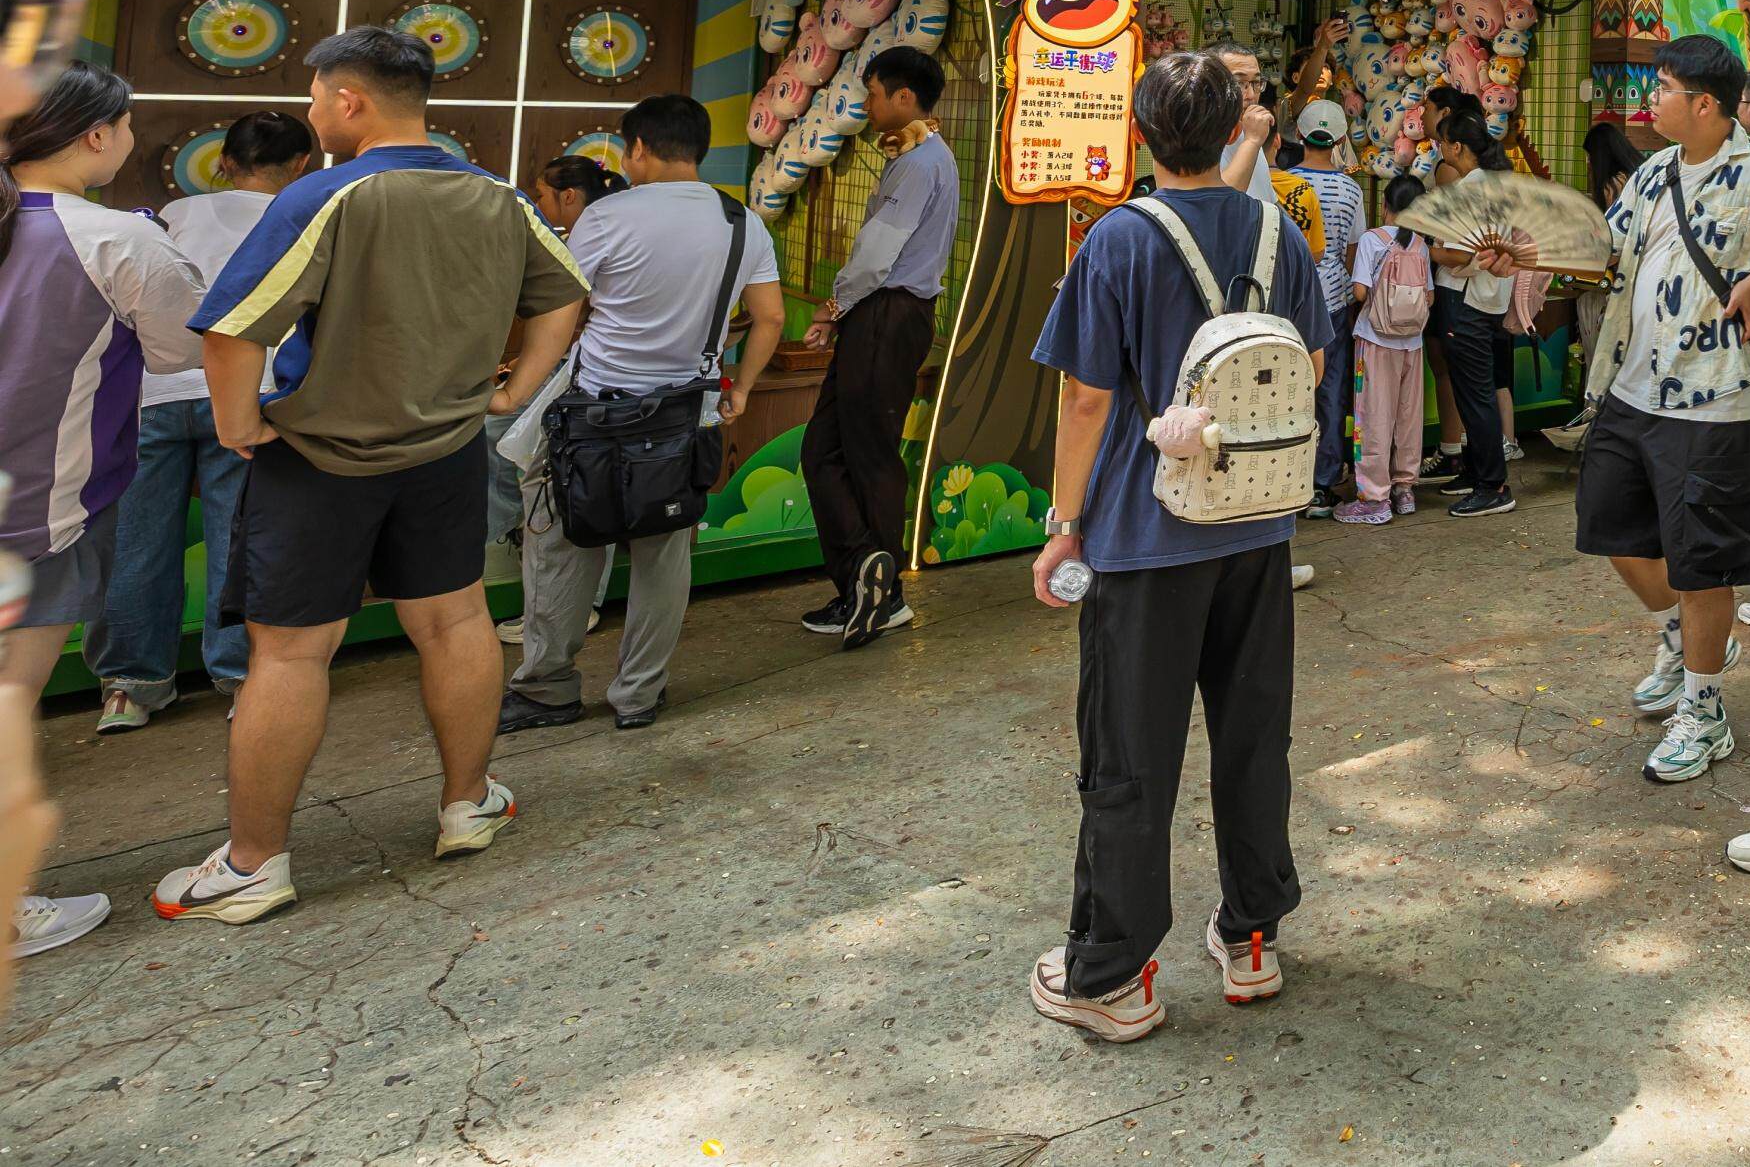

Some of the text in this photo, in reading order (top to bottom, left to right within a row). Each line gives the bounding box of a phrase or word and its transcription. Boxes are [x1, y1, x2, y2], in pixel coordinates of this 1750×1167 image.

[1033, 46, 1118, 73] 幸运平衡球
[1025, 76, 1066, 88] 游戏玩法
[1021, 137, 1062, 148] 奖励机制
